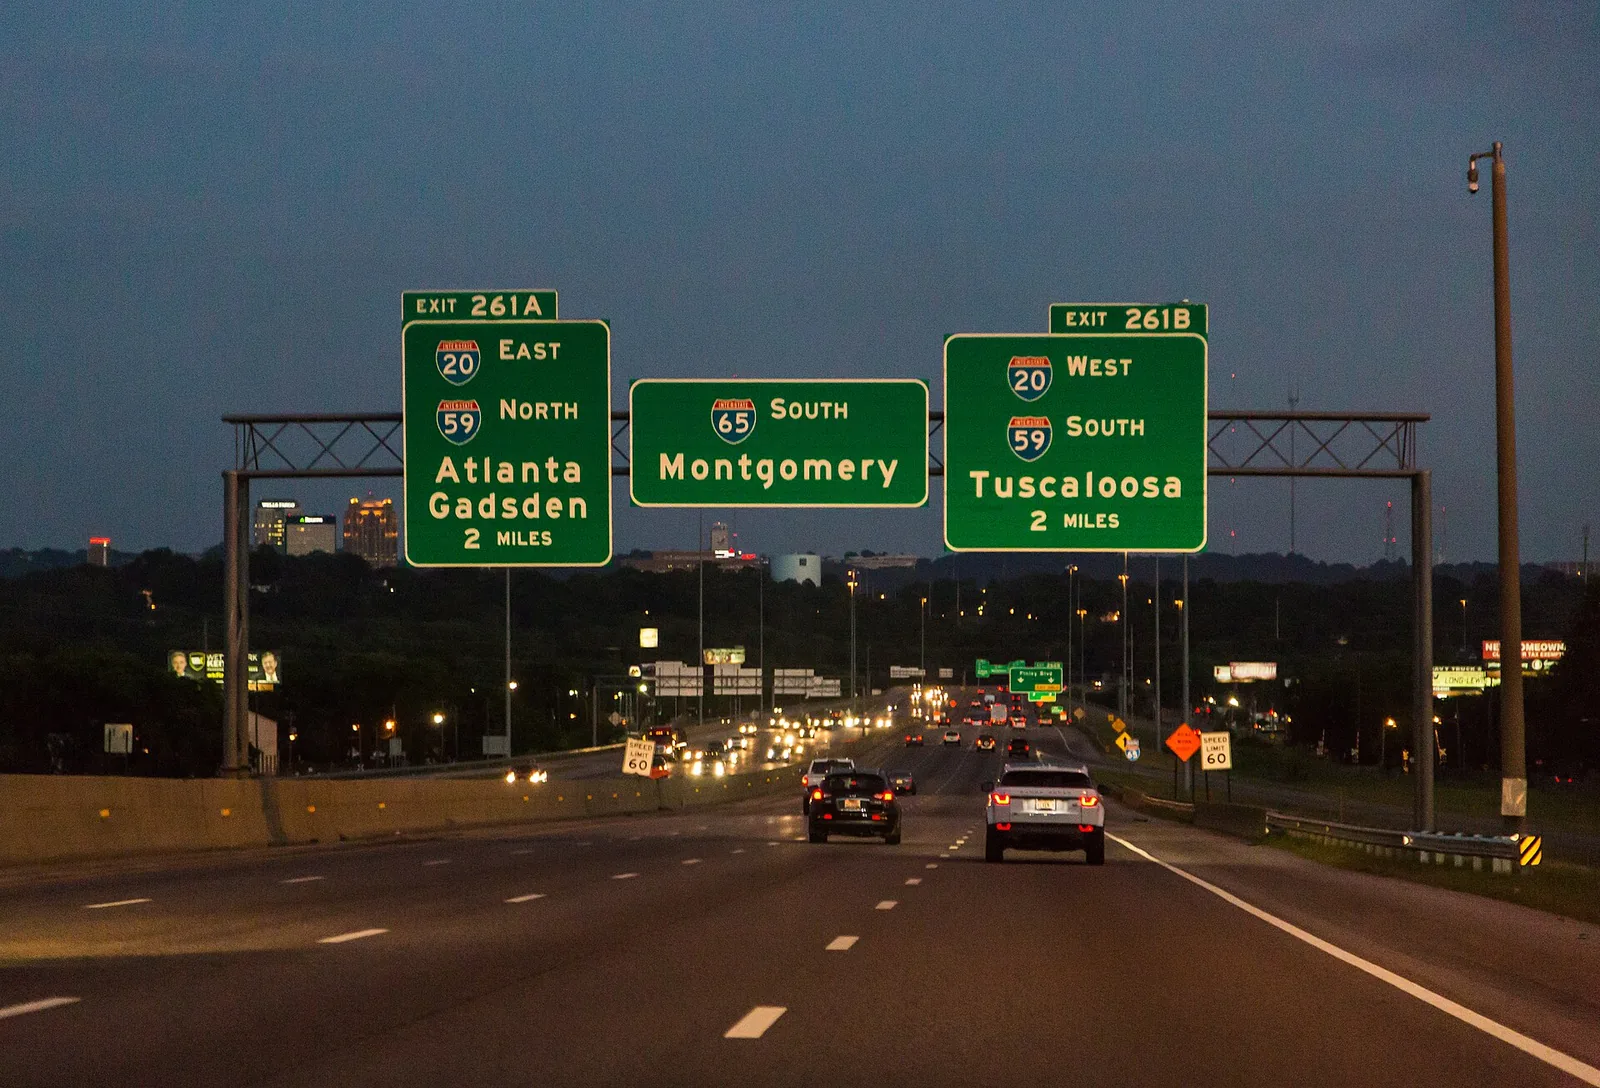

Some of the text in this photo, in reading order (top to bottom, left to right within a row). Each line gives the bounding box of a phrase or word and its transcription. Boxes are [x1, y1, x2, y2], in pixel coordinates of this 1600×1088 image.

[416, 295, 543, 317] EXIT 261A
[1066, 308, 1191, 330] EXIT 261B
[441, 342, 474, 350] INTERSTATE
[499, 339, 561, 360] EAST
[443, 353, 474, 375] 20
[1067, 356, 1133, 376] WEST
[1014, 370, 1046, 391] 20
[442, 402, 474, 410] INTERSTATE
[500, 399, 578, 420] NORTH
[718, 401, 750, 409] INTERSTATE
[770, 398, 848, 419] SOUTH
[444, 413, 474, 435] 59
[718, 413, 749, 433] 65
[1066, 416, 1145, 436] SOUTH
[1014, 430, 1045, 451] 59
[435, 457, 581, 484] Atlanta
[660, 453, 898, 489] Montgomery
[969, 470, 1182, 498] Tuscaloosa
[429, 491, 587, 519] Gadsden
[1030, 510, 1120, 531] 2 MILES
[464, 528, 553, 549] 2 MILES
[1485, 643, 1500, 651] NE
[629, 742, 653, 751] SPEED
[1203, 736, 1228, 744] SPEED
[628, 759, 648, 771] 60
[630, 751, 649, 759] LIMIT
[1207, 753, 1226, 764] 60
